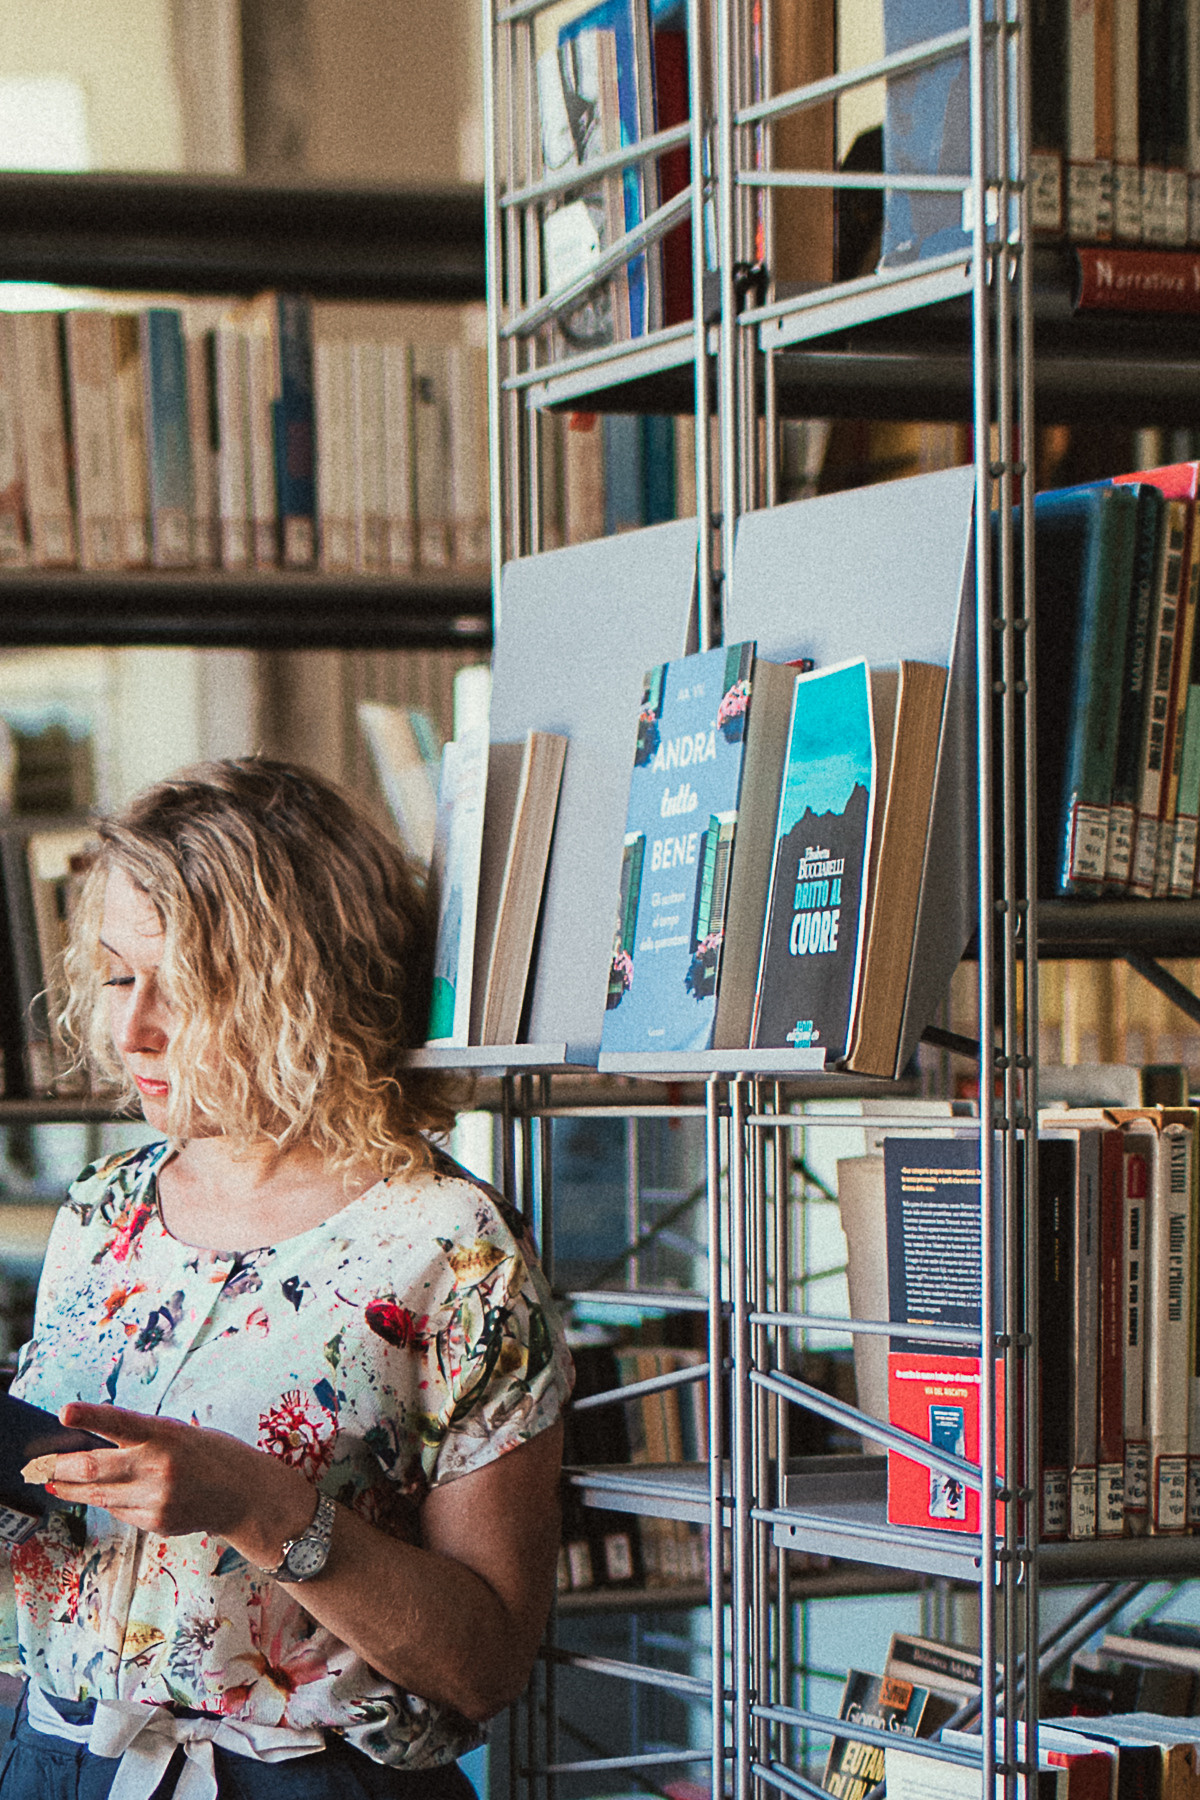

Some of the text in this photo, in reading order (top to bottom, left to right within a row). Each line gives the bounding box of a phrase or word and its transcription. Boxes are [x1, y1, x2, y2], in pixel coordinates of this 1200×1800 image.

[1096, 260, 1185, 291] Narrativa
[652, 720, 717, 774] ANDRÀ
[660, 783, 698, 818] tutto
[651, 832, 699, 872] BENE
[793, 878, 841, 910] DRITTO AL
[789, 909, 840, 956] CUORE
[1170, 1211, 1186, 1252] Addio
[1170, 1256, 1183, 1264] e
[1169, 1267, 1184, 1322] ritorno
